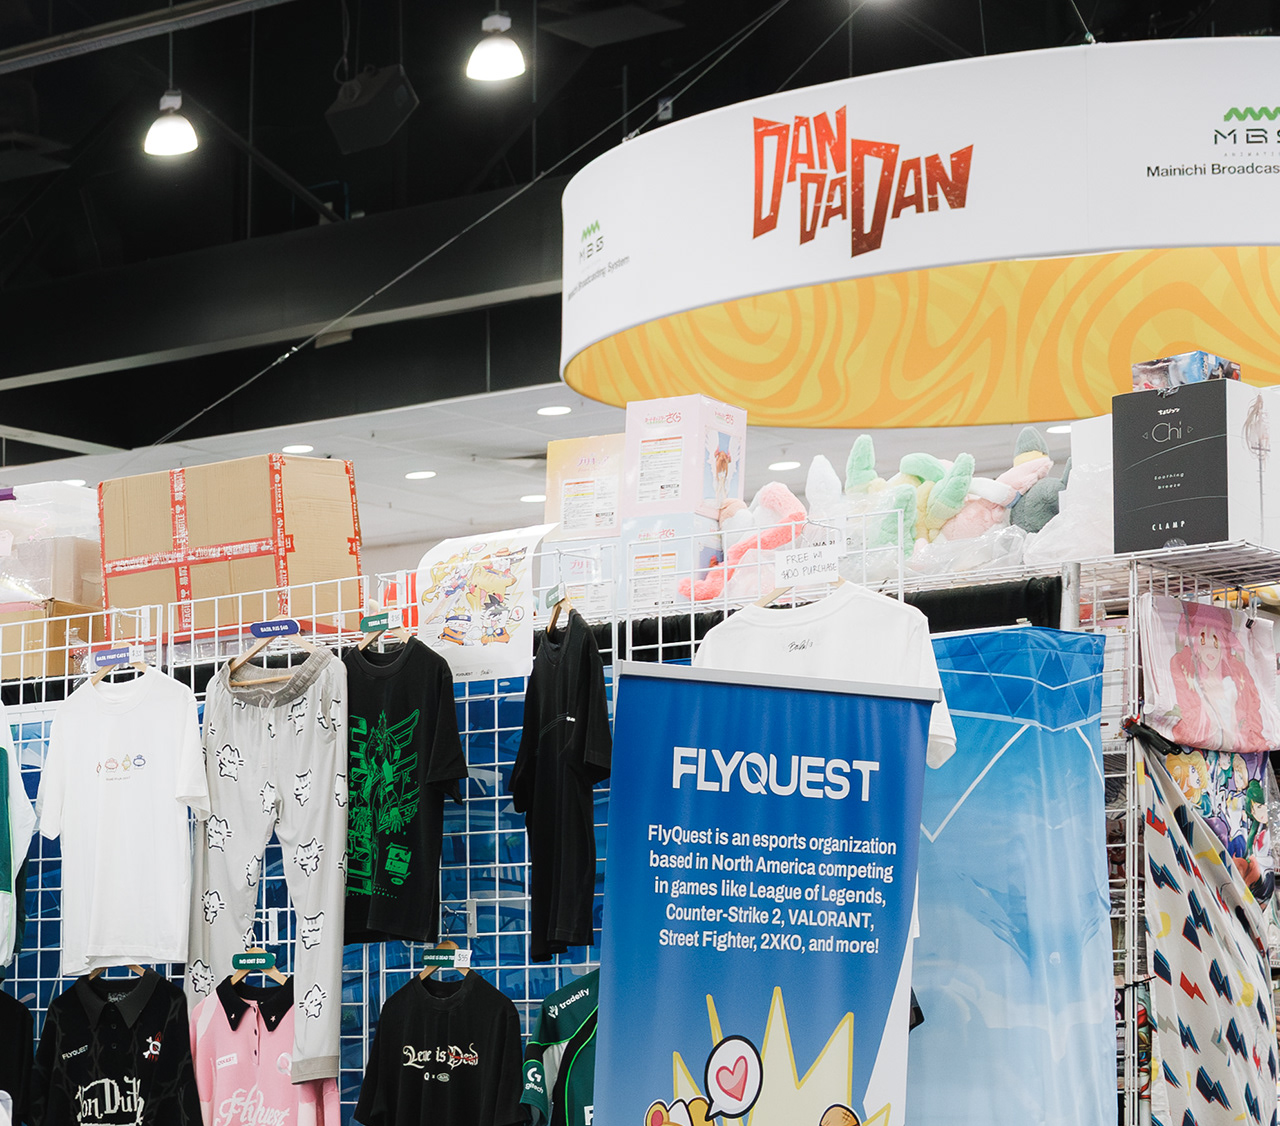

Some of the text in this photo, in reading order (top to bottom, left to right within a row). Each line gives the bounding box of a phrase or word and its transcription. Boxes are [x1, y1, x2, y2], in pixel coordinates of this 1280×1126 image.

[1214, 128, 1280, 145] MB
[753, 105, 847, 240] DAN
[1146, 163, 1207, 178] Mainichi
[1151, 421, 1182, 443] Chi
[1151, 520, 1186, 531] CLAMP
[786, 551, 809, 565] FREE
[802, 561, 837, 577] PURCHASE
[672, 746, 880, 802] FLYQUEST
[647, 824, 897, 857] FlyQuest is an esports organization
[649, 850, 894, 884] based in North America competing
[654, 877, 887, 908] in games like League of Legends,
[665, 902, 875, 932] Counter-Strike 2, VALORANT,
[659, 929, 880, 955] Street Fighter, 2XKO, and more!
[558, 988, 590, 1010] tradeify
[61, 1044, 89, 1061] FLYQUEST
[435, 1046, 447, 1062] is
